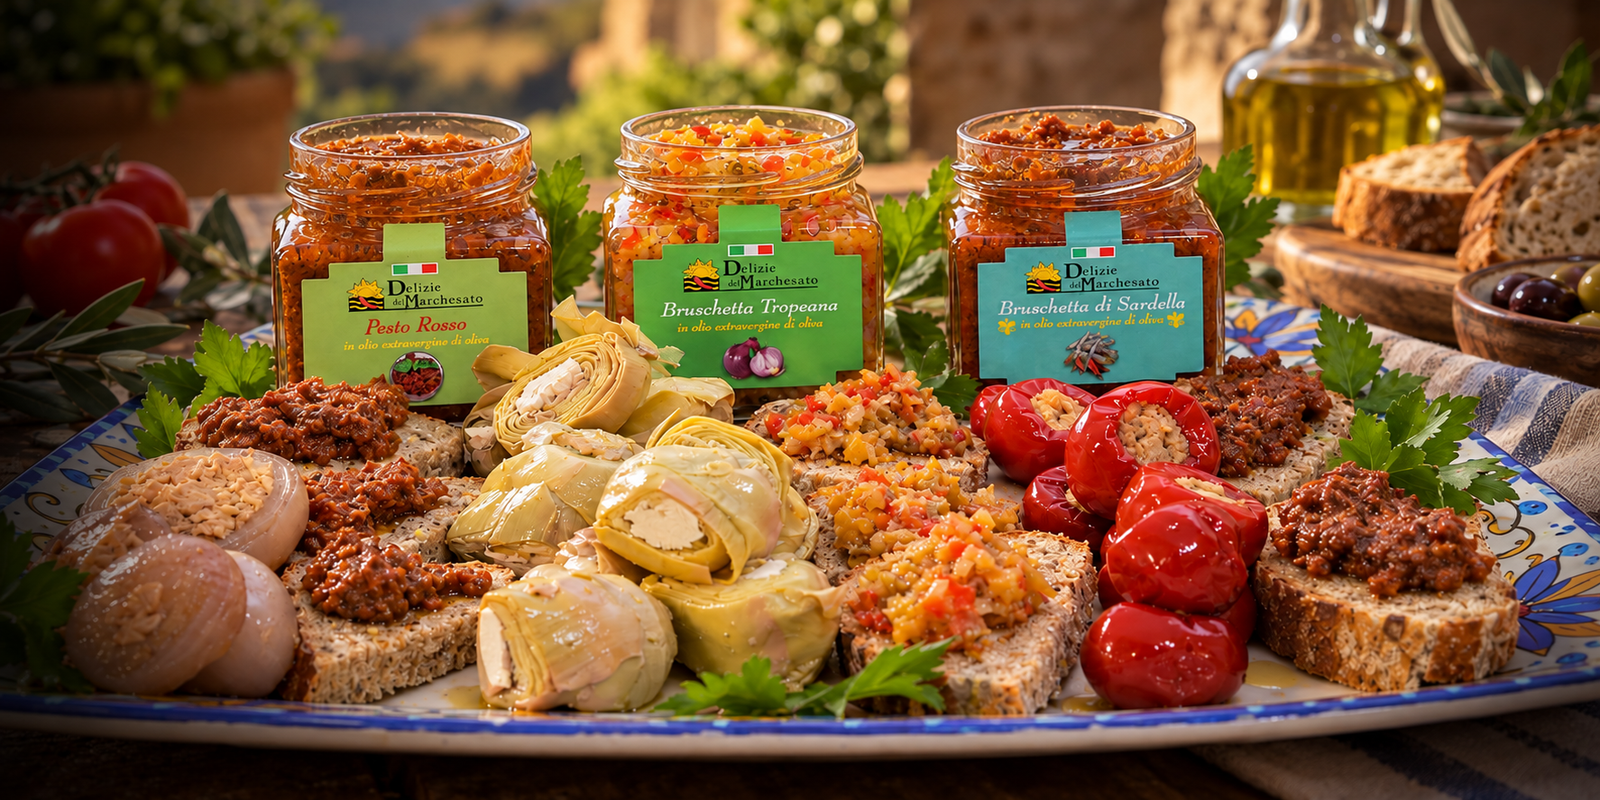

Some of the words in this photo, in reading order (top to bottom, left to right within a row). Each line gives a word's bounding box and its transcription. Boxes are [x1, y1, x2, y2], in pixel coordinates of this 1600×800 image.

[723, 260, 776, 276] Delizie
[1064, 263, 1118, 279] Delizie
[387, 280, 441, 296] Delizie
[740, 275, 818, 290] Marchesato
[1081, 277, 1160, 292] Marchesato
[404, 294, 484, 309] Marchesato
[660, 298, 754, 318] Bruschetta
[760, 298, 838, 318] Tropeana
[998, 298, 1089, 316] Bruschetta
[1094, 295, 1112, 312] di
[1117, 292, 1186, 312] Sardella
[364, 318, 410, 336] Pesto
[416, 316, 467, 333] Rosso
[677, 324, 688, 332] in
[691, 320, 712, 332] olio
[715, 320, 780, 332] extravergine
[784, 316, 795, 329] di
[798, 316, 823, 328] oliva
[1020, 319, 1030, 329] in
[1034, 316, 1054, 329] olio
[1056, 316, 1122, 329] extravergine
[1124, 314, 1136, 326] di
[1138, 313, 1164, 325] oliva
[344, 342, 354, 350] in
[358, 338, 378, 350] olio
[382, 337, 448, 350] extravergine
[451, 334, 462, 345] di
[464, 333, 490, 344] oliva
